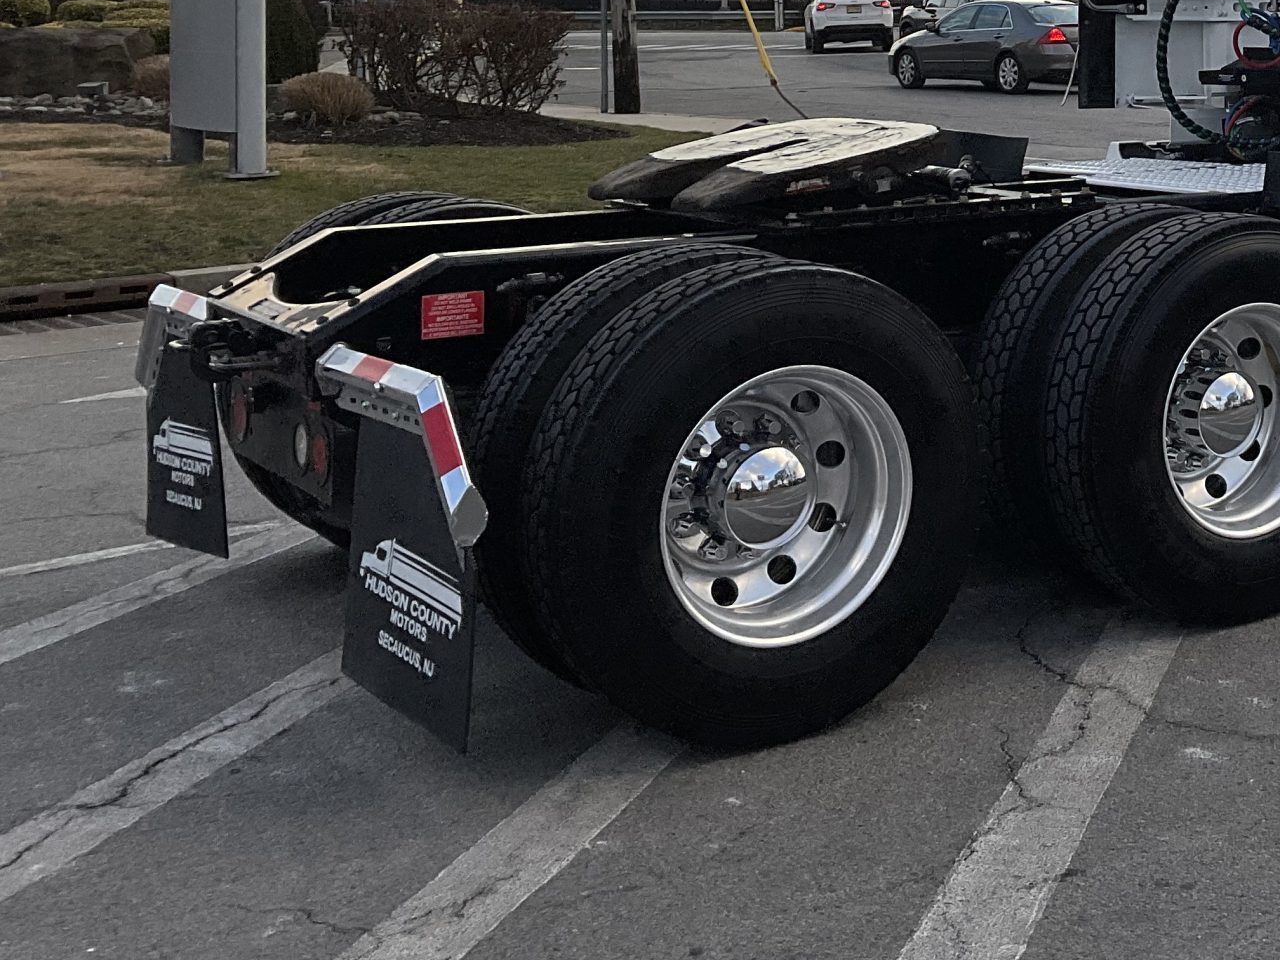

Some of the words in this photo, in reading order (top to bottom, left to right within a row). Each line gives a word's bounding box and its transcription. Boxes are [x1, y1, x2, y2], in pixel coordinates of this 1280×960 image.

[181, 458, 211, 477] COUNTY
[364, 573, 409, 611] HUDSON
[410, 600, 456, 640] COUNTY
[389, 608, 427, 642] MOTORS
[378, 630, 422, 672] SECAUCUS,
[423, 658, 435, 677] NJ
